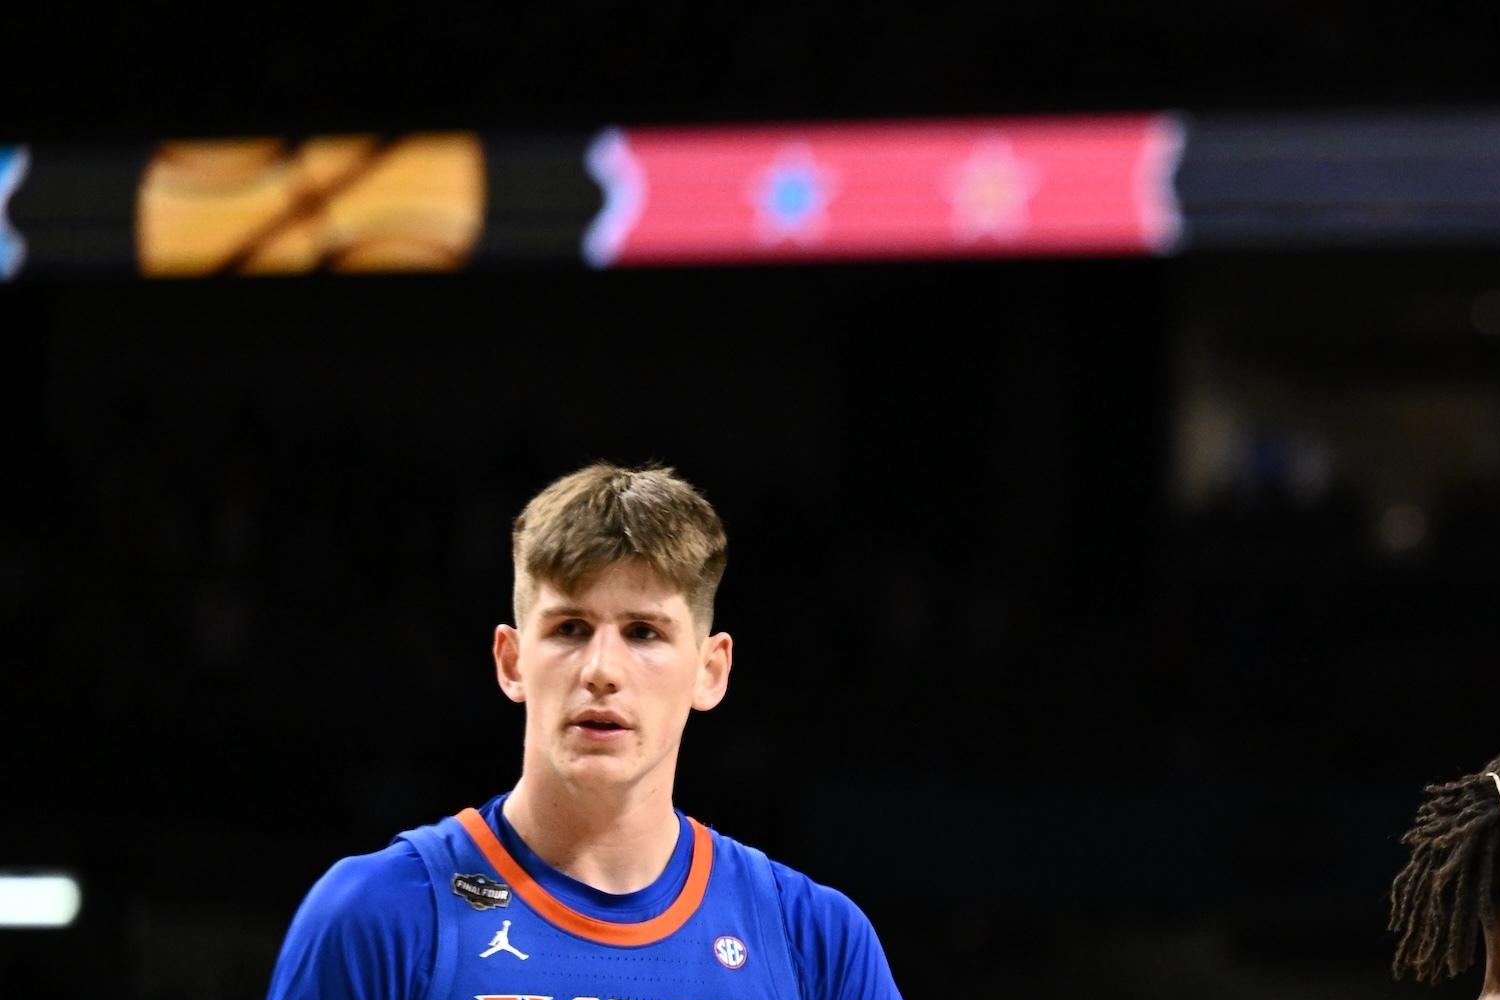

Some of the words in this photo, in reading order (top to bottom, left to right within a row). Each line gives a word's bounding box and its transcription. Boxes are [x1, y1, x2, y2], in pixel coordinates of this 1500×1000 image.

[456, 879, 481, 895] FINAL
[482, 888, 509, 900] FOUR
[716, 938, 745, 966] SEC
